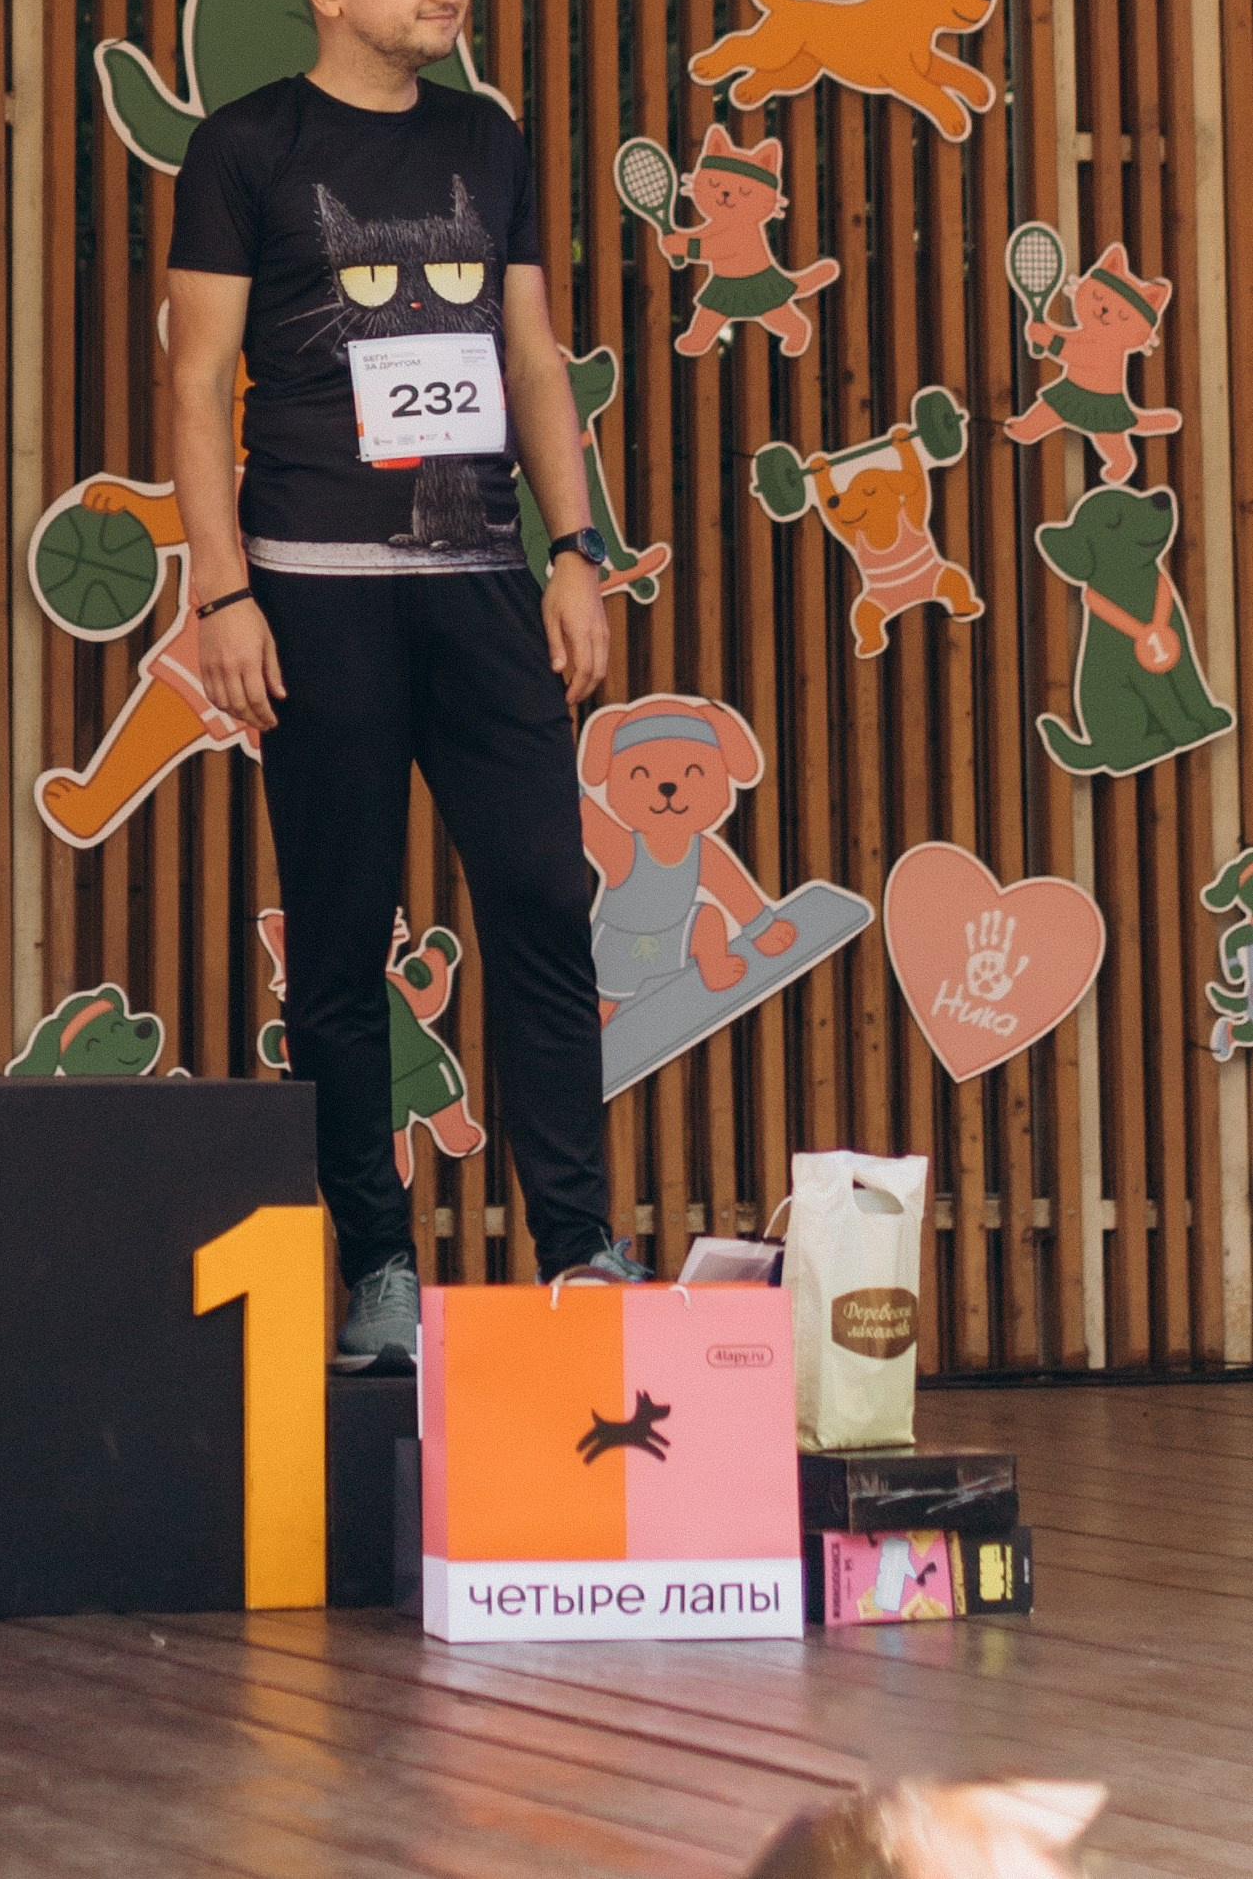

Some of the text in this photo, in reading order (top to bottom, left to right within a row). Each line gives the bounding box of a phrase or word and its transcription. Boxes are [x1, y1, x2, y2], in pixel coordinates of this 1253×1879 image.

[363, 353, 388, 362] БЕГИ
[389, 380, 480, 418] 232
[1147, 632, 1170, 664] 1
[930, 979, 1019, 1038] Ника
[193, 1205, 328, 1610] 1
[468, 1580, 779, 1616] четыре лапы
